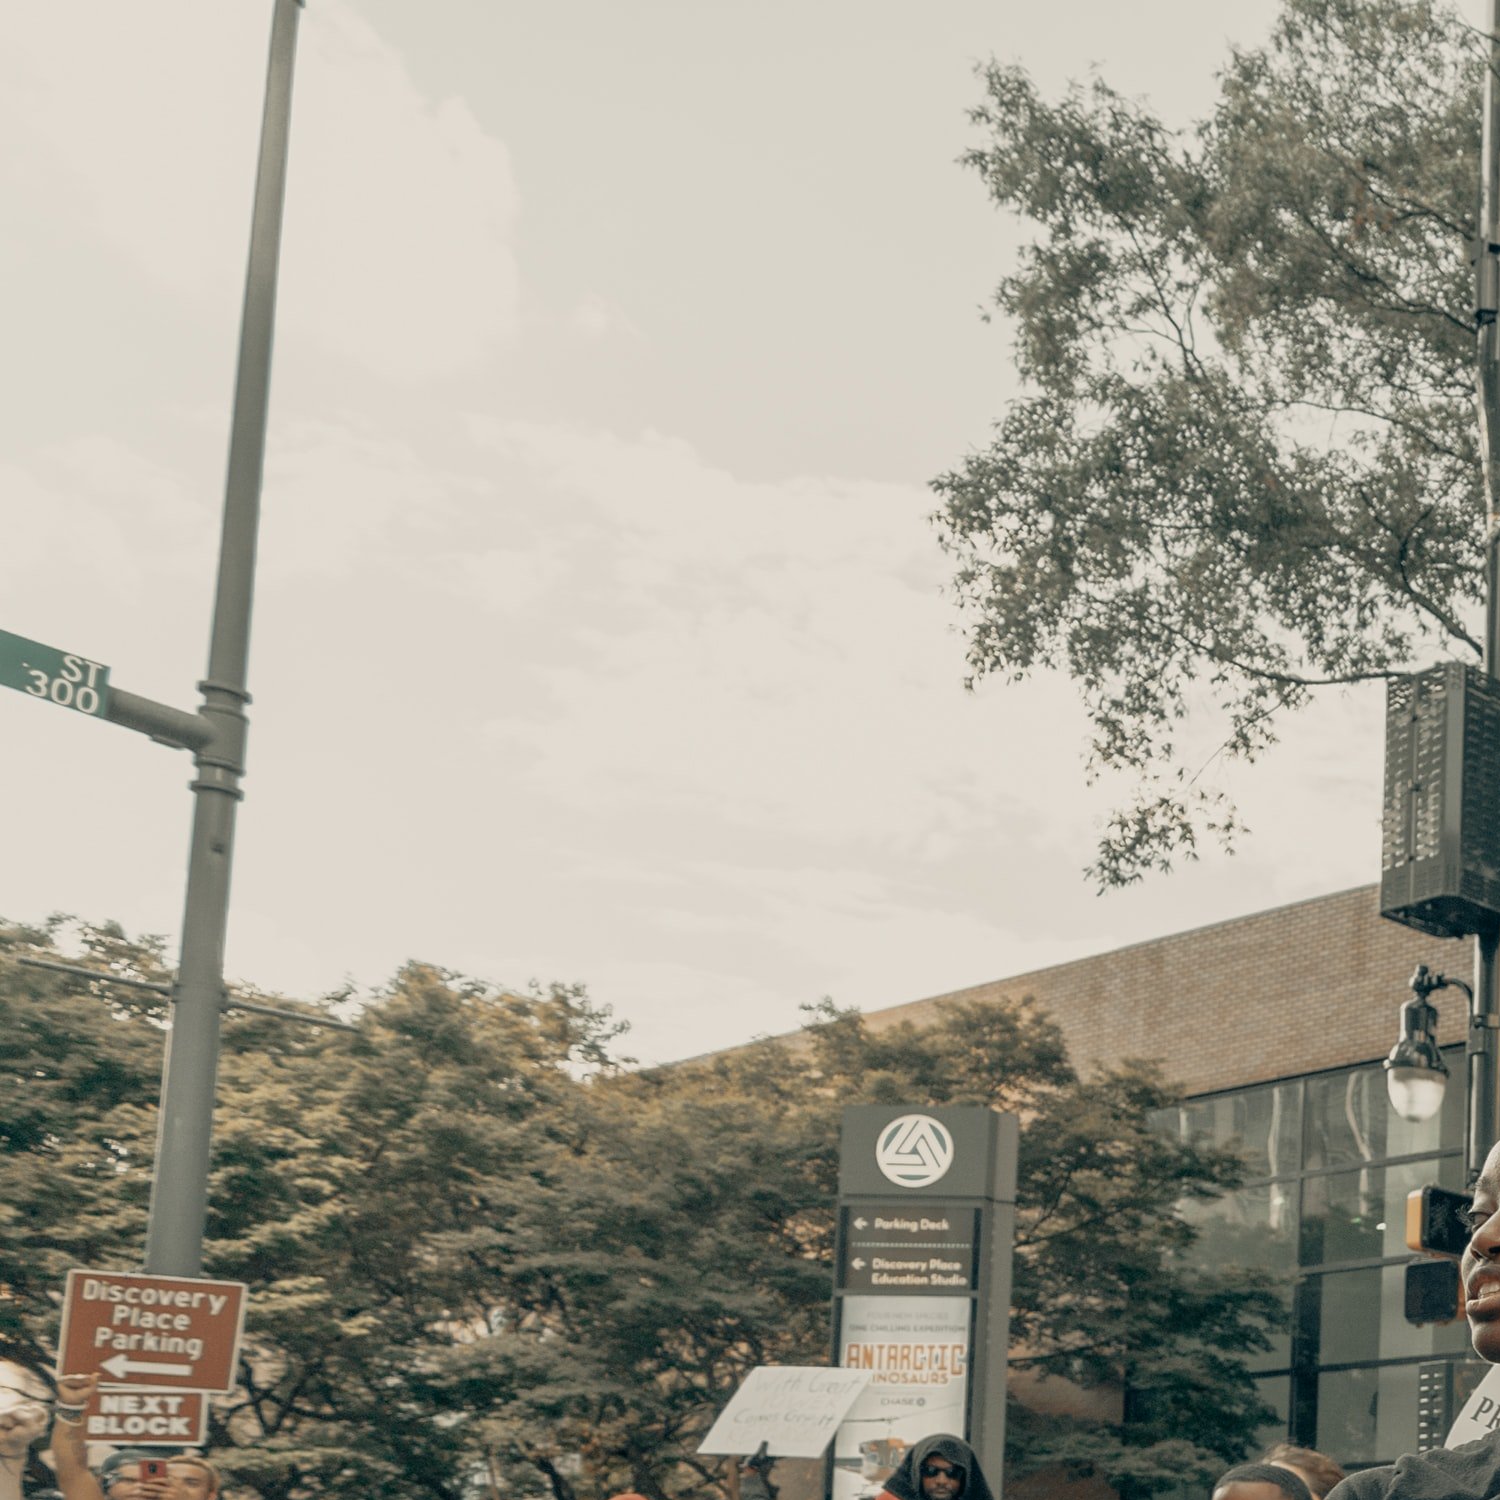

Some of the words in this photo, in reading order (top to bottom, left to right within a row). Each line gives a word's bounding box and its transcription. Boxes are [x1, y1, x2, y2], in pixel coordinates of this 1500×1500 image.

[60, 655, 104, 687] ST
[26, 669, 99, 715] 300
[874, 1217, 919, 1233] Parking
[920, 1217, 950, 1231] Deck
[872, 1257, 927, 1273] Discovery
[929, 1258, 963, 1272] Place
[871, 1272, 929, 1285] Education
[930, 1273, 969, 1286] Studio
[82, 1278, 228, 1316] Discovery
[111, 1304, 192, 1331] Place
[93, 1326, 204, 1361] Parking
[846, 1343, 965, 1375] ANTARCTIC
[872, 1371, 949, 1385] INOSAURS
[100, 1395, 185, 1414] NEXT
[880, 1397, 914, 1406] CHASE
[86, 1414, 192, 1436] BLOCK
